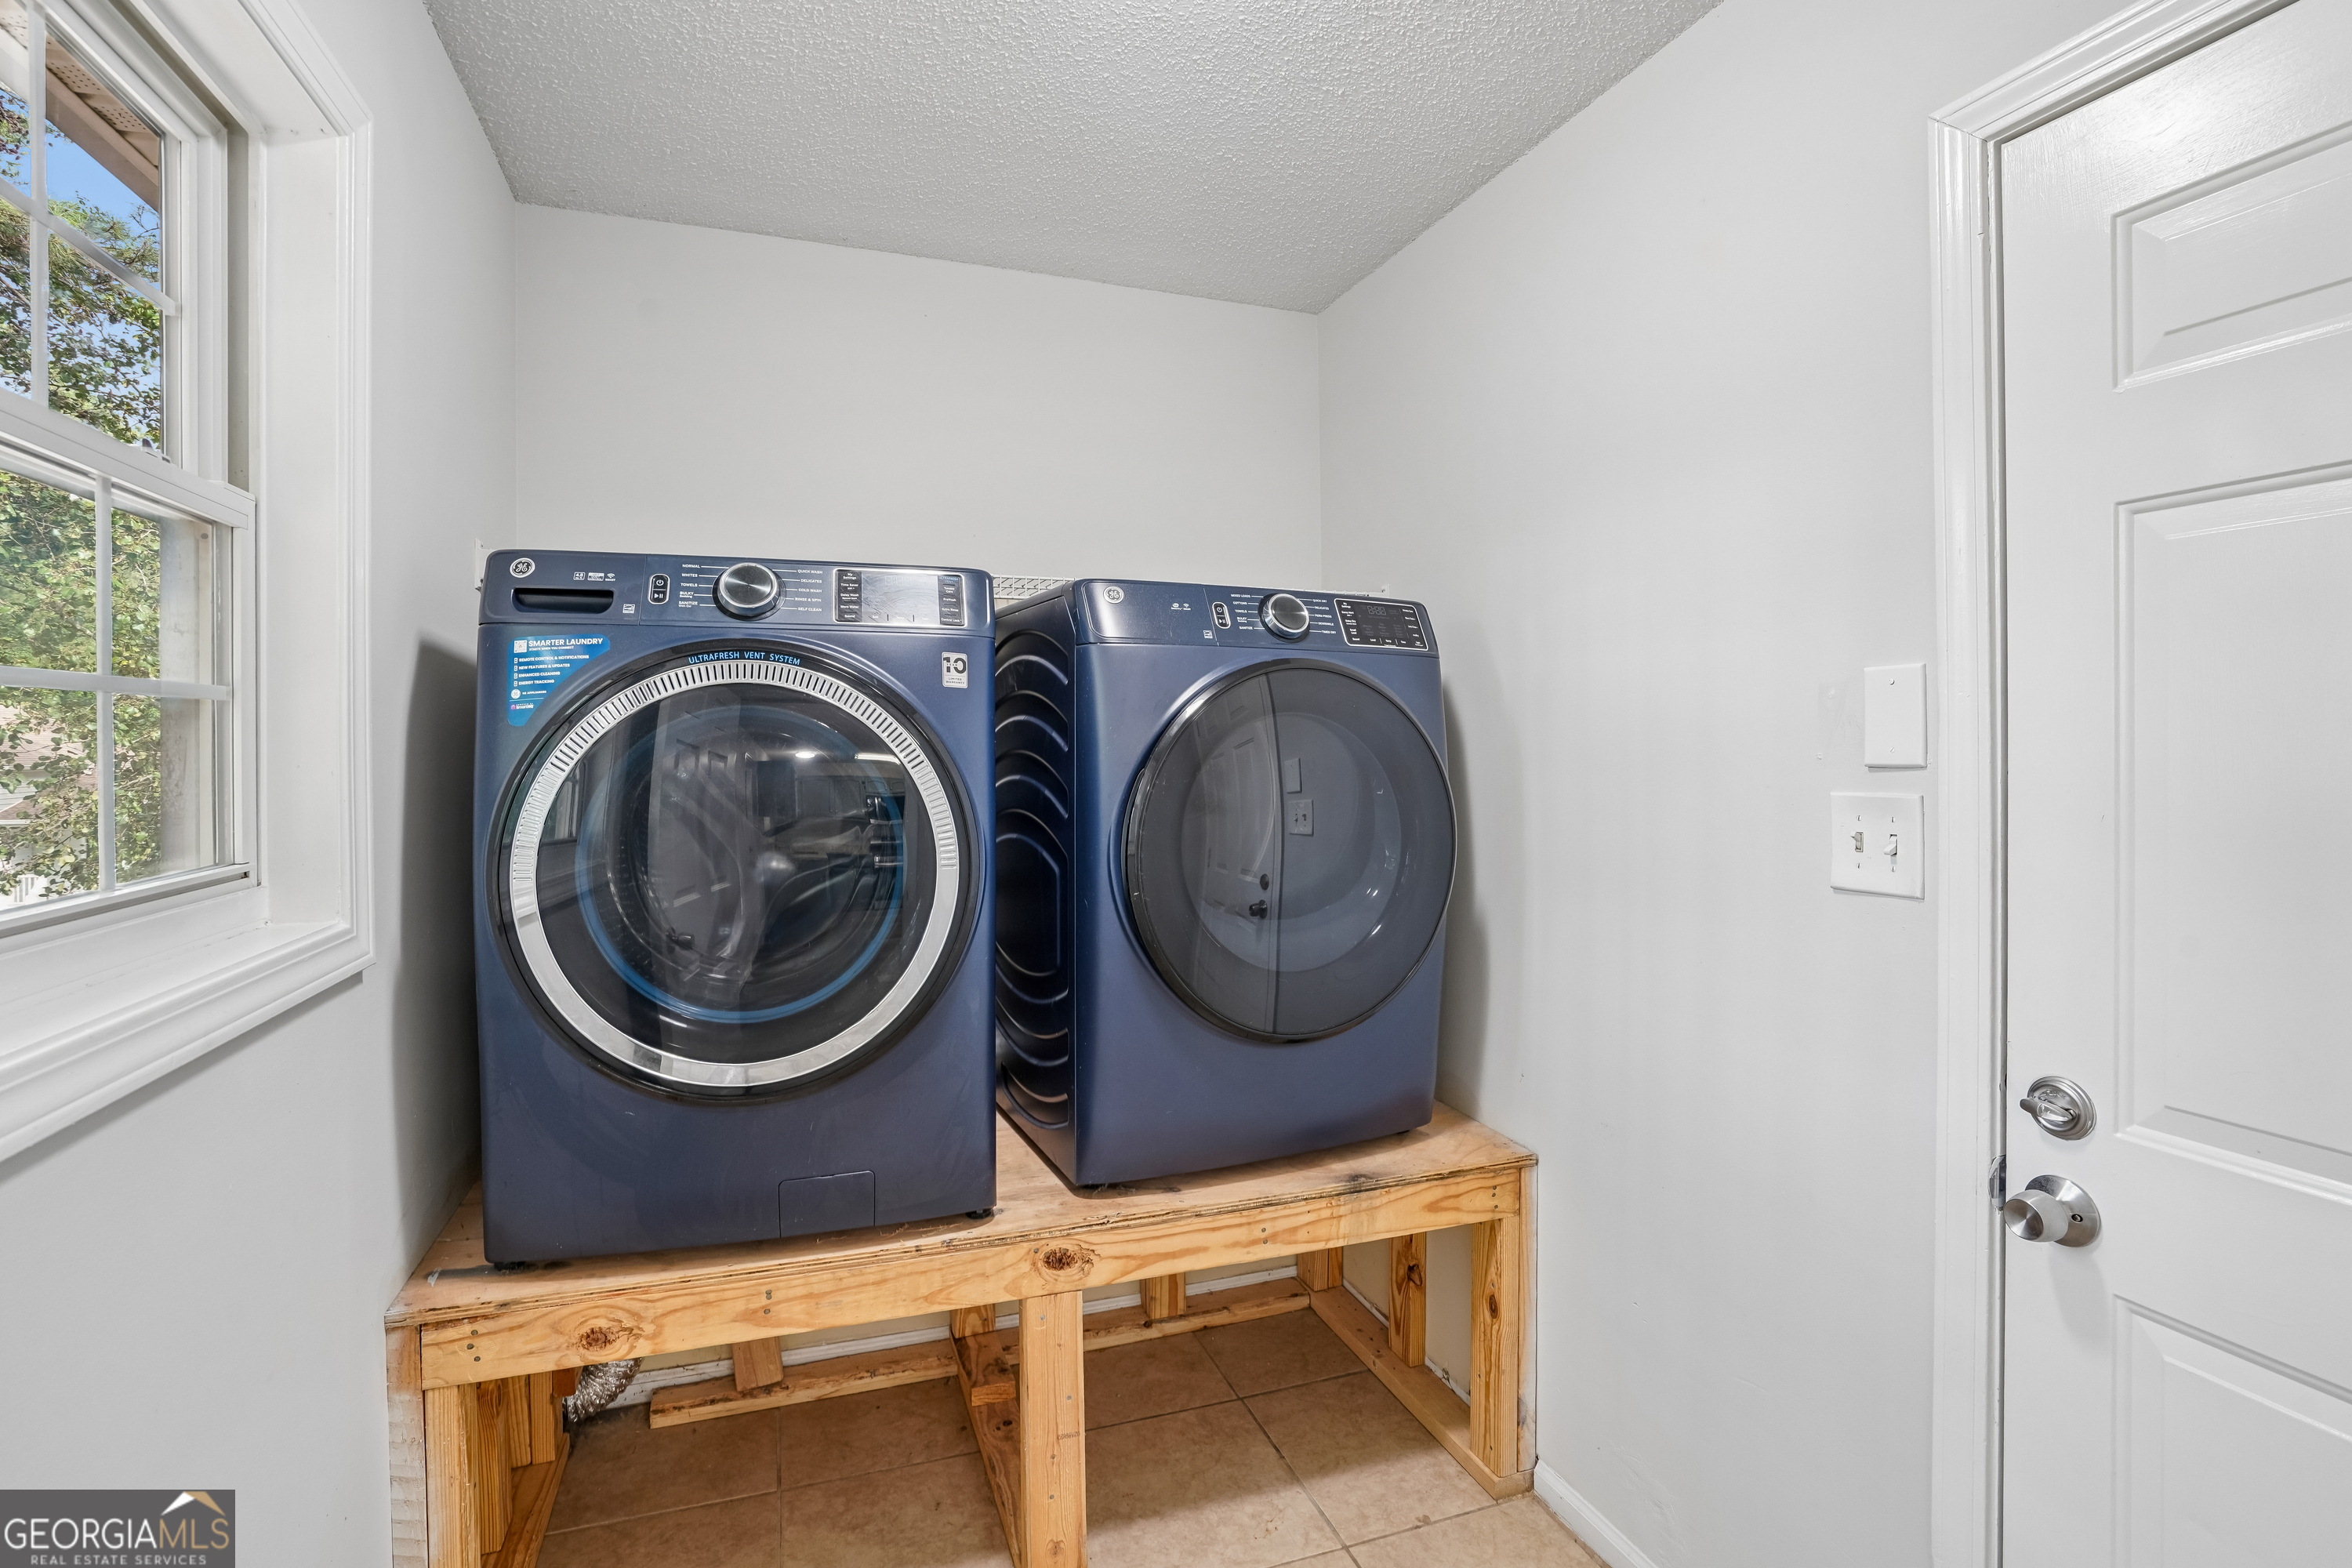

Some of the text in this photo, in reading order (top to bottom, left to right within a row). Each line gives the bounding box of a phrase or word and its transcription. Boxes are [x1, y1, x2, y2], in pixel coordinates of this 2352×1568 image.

[688, 651, 800, 666] ULTRAFRESH VENT SYSTEM
[943, 657, 966, 674] 10
